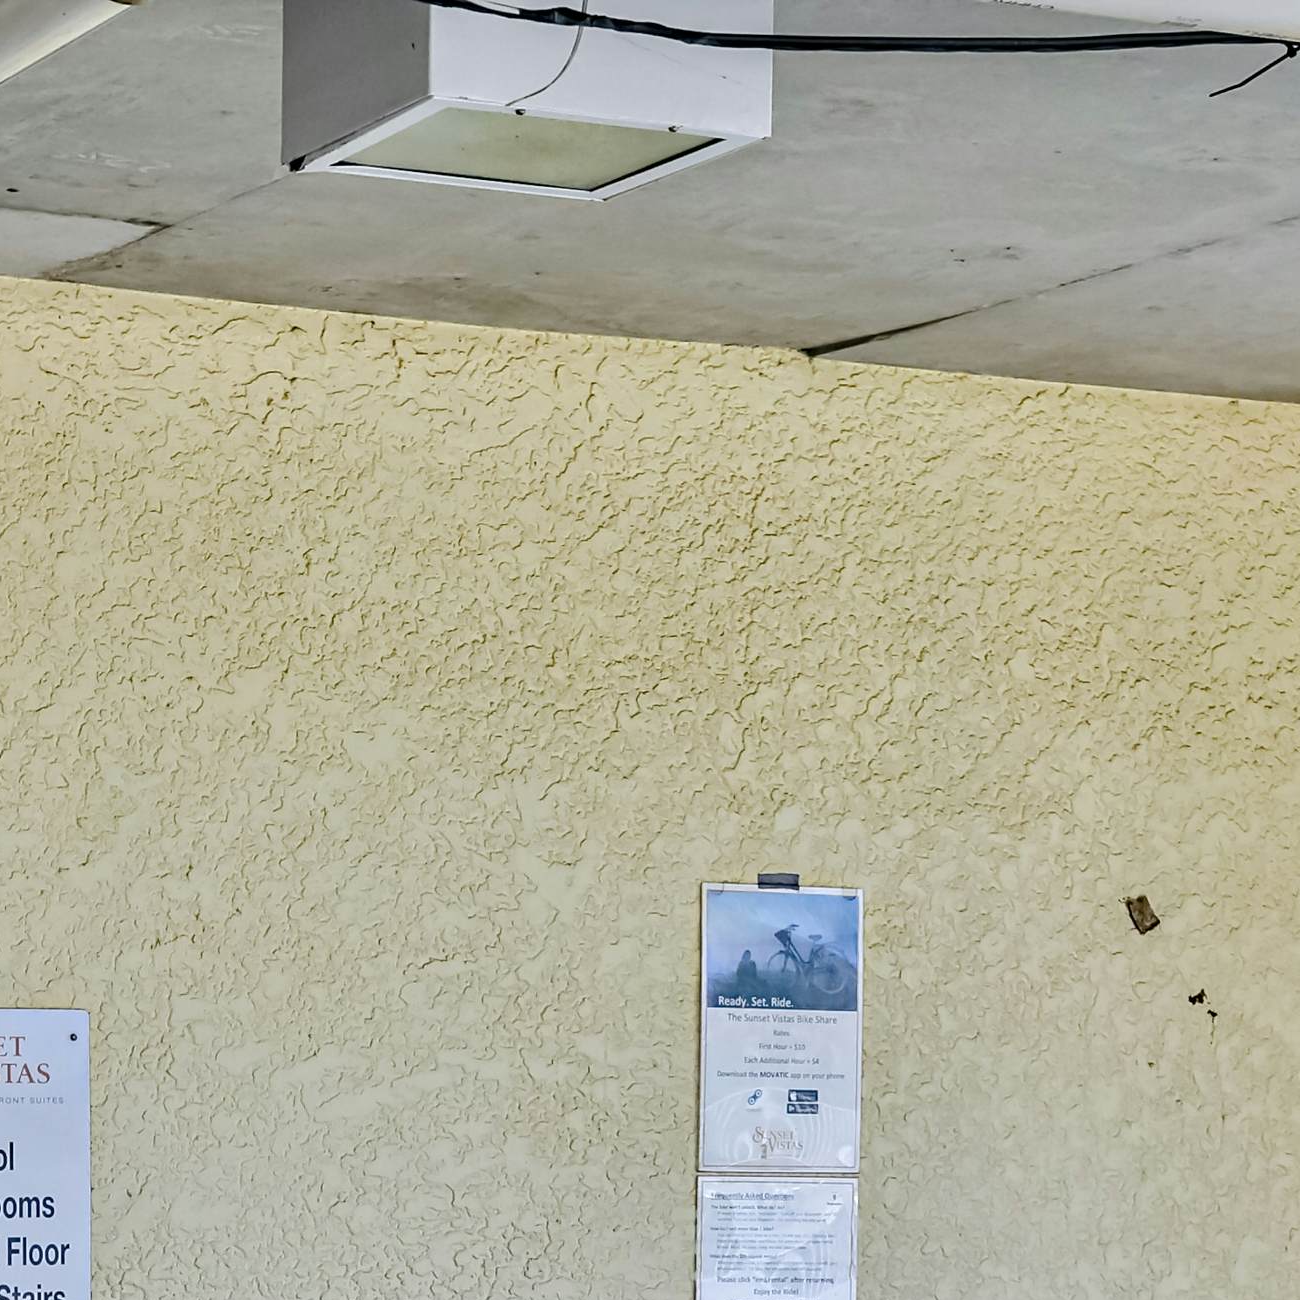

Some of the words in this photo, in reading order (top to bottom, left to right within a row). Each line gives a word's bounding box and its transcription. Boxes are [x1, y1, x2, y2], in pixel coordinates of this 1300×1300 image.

[718, 995, 749, 1009] Ready.
[751, 996, 769, 1007] Set.
[771, 997, 794, 1008] Ride.
[728, 1013, 742, 1022] The
[744, 1013, 770, 1023] Sunset
[772, 1014, 795, 1023] Vistas
[797, 1015, 814, 1024] Bike
[815, 1015, 837, 1024] Share
[29, 1097, 64, 1105] SUITES
[7, 1236, 70, 1266] Floor
